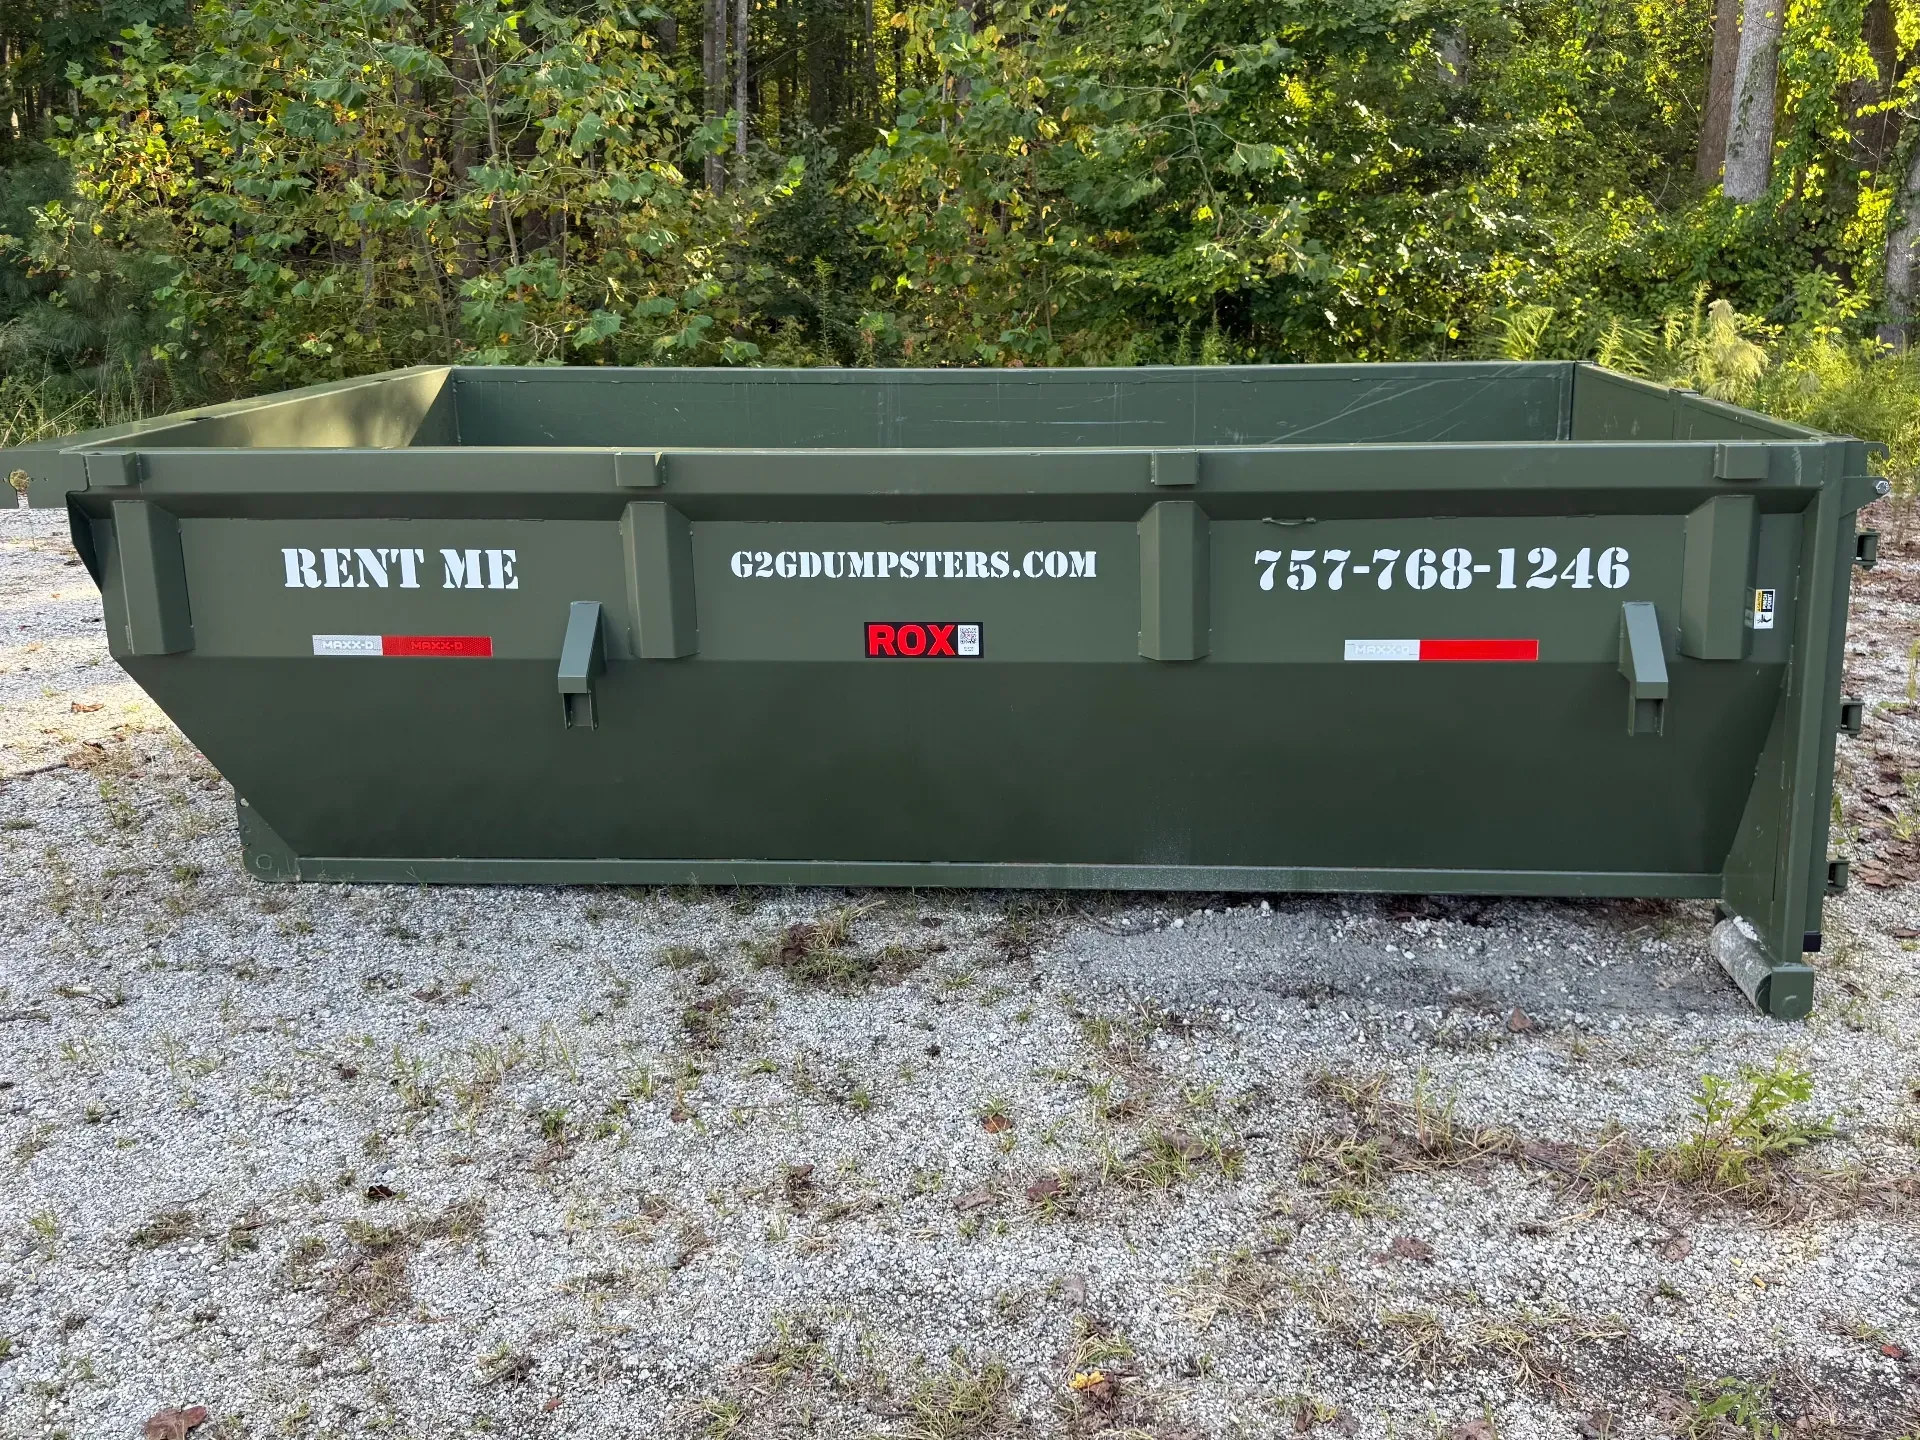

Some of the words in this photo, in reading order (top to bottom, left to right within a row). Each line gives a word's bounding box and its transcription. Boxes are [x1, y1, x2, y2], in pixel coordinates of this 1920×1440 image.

[281, 548, 424, 589] RENT
[439, 548, 519, 590] ME
[730, 550, 1097, 579] G2GDUMPSTERS.COM
[1254, 547, 1630, 591] 757-768-1246
[322, 640, 374, 650] MAXX-D
[411, 641, 463, 650] MAXX-D
[868, 624, 956, 656] ROX
